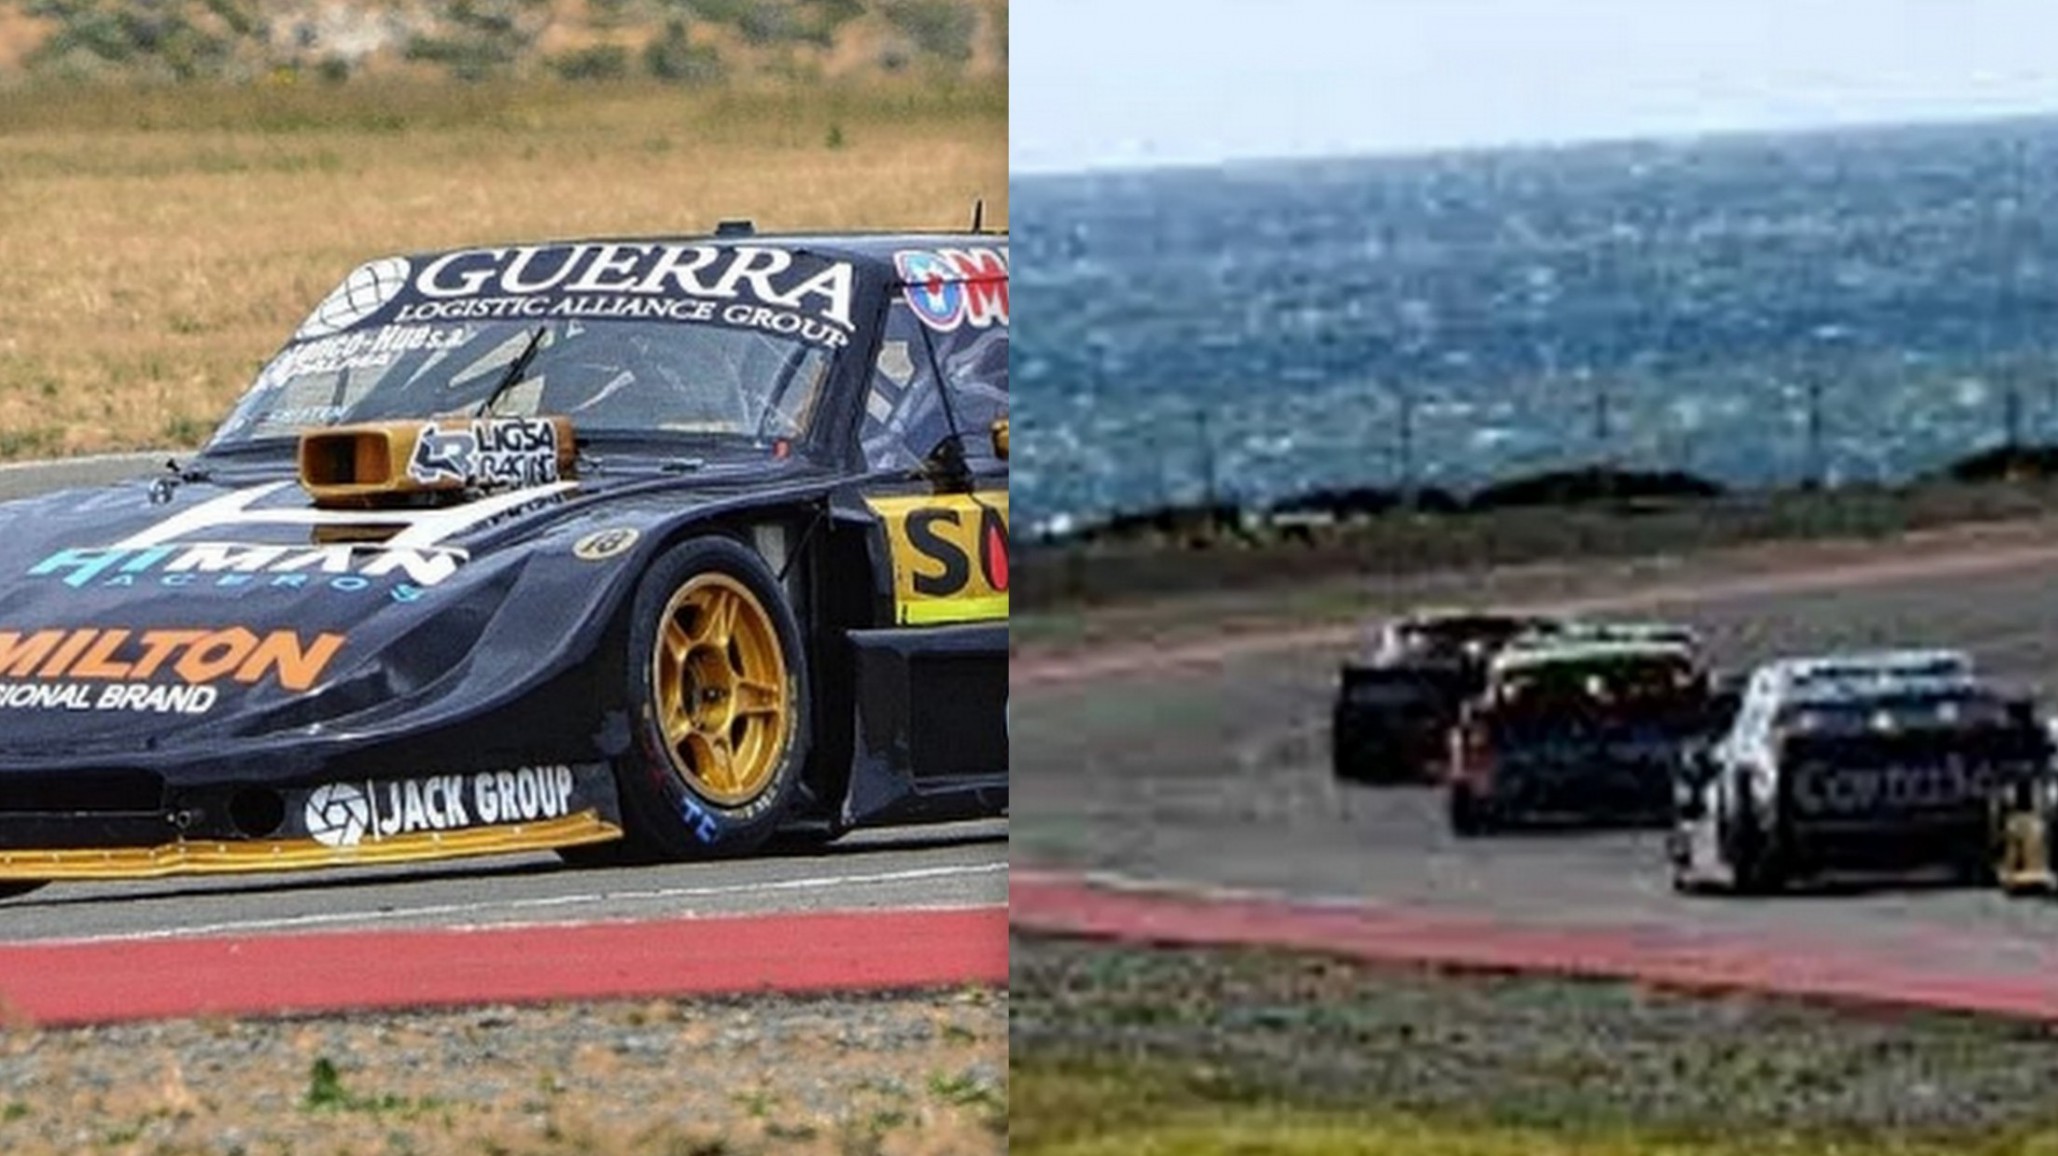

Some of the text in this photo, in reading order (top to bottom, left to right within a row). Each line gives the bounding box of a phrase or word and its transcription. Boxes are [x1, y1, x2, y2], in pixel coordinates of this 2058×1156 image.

[416, 243, 855, 331] GUERRA
[398, 296, 850, 348] LOGISTIC ALLIANCE GROUP
[476, 421, 555, 453] LIGSA
[27, 543, 470, 587] HIMAN
[103, 572, 425, 602] ACEROS
[96, 684, 218, 714] BRAND
[381, 765, 573, 835] JACK GROUP
